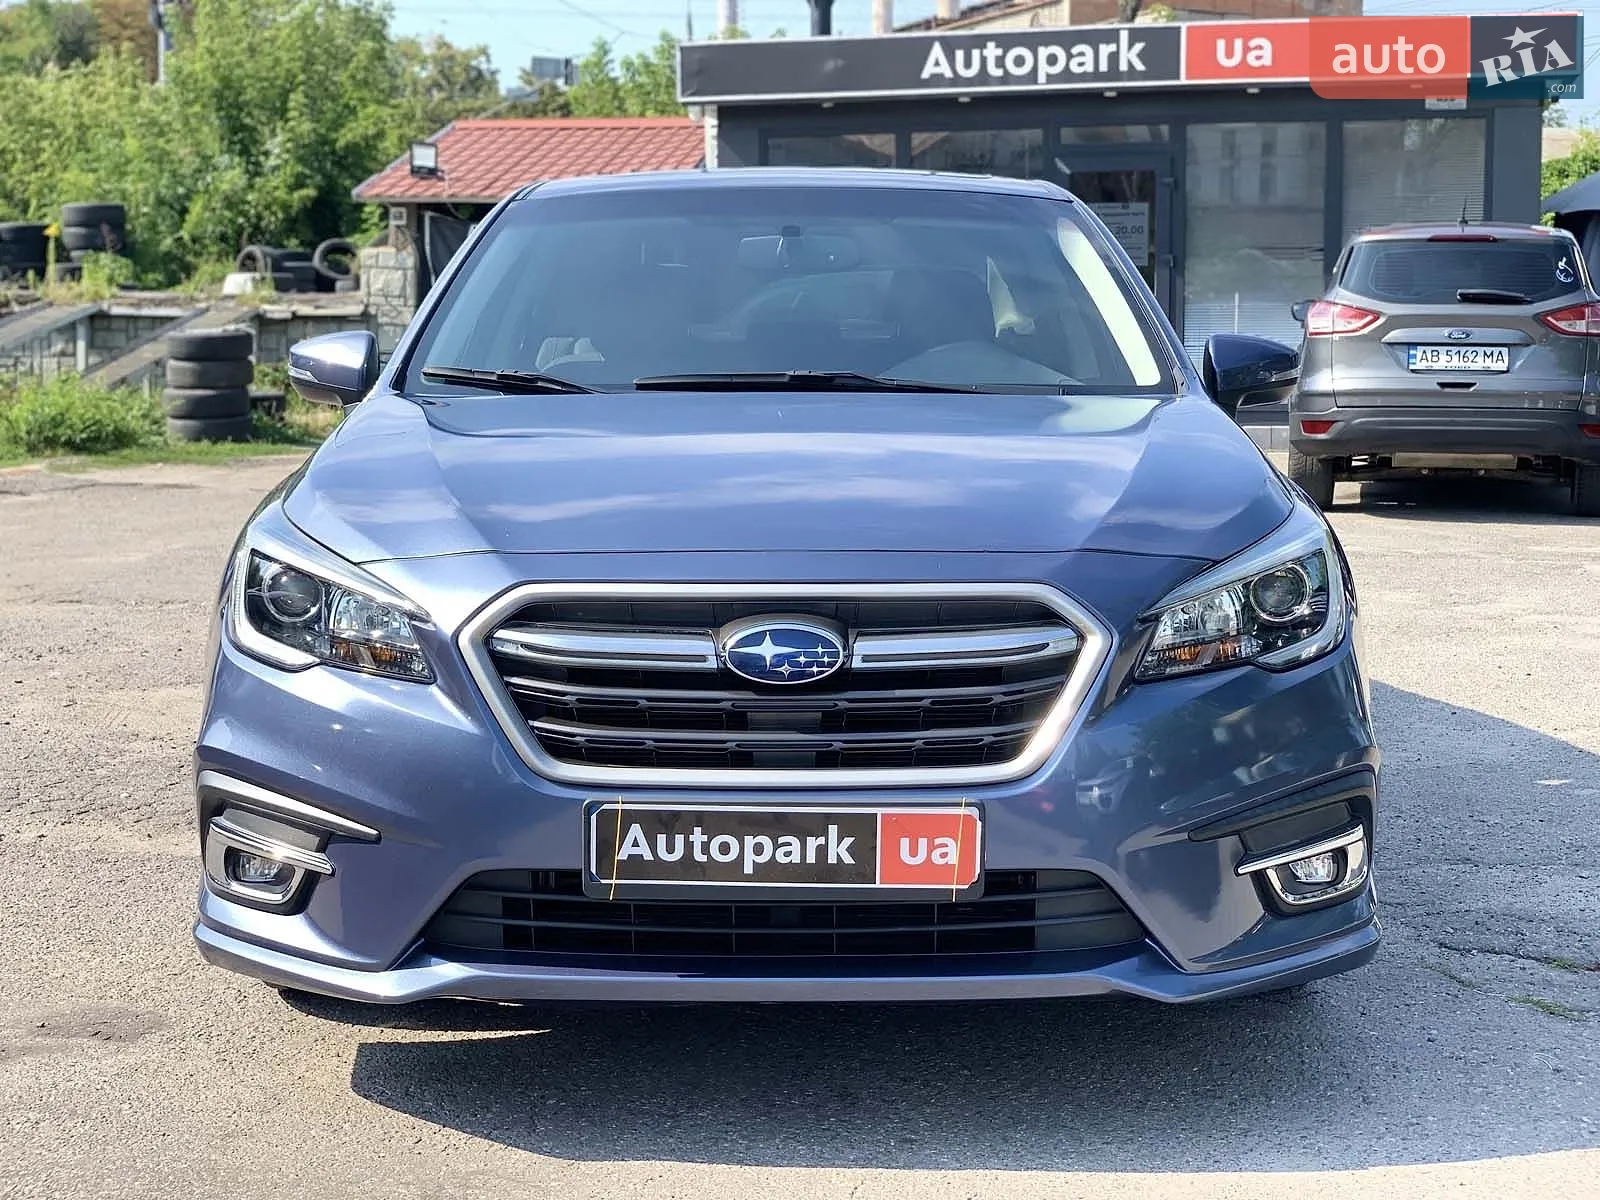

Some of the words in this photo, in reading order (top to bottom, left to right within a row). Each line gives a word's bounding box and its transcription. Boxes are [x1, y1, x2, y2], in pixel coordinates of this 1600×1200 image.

[920, 30, 1147, 84] Autopark
[1215, 37, 1273, 70] ua
[1419, 349, 1440, 363] AB
[1445, 350, 1479, 364] 5162
[1483, 350, 1505, 364] MA
[616, 823, 856, 874] Autopark
[898, 836, 959, 866] ua
